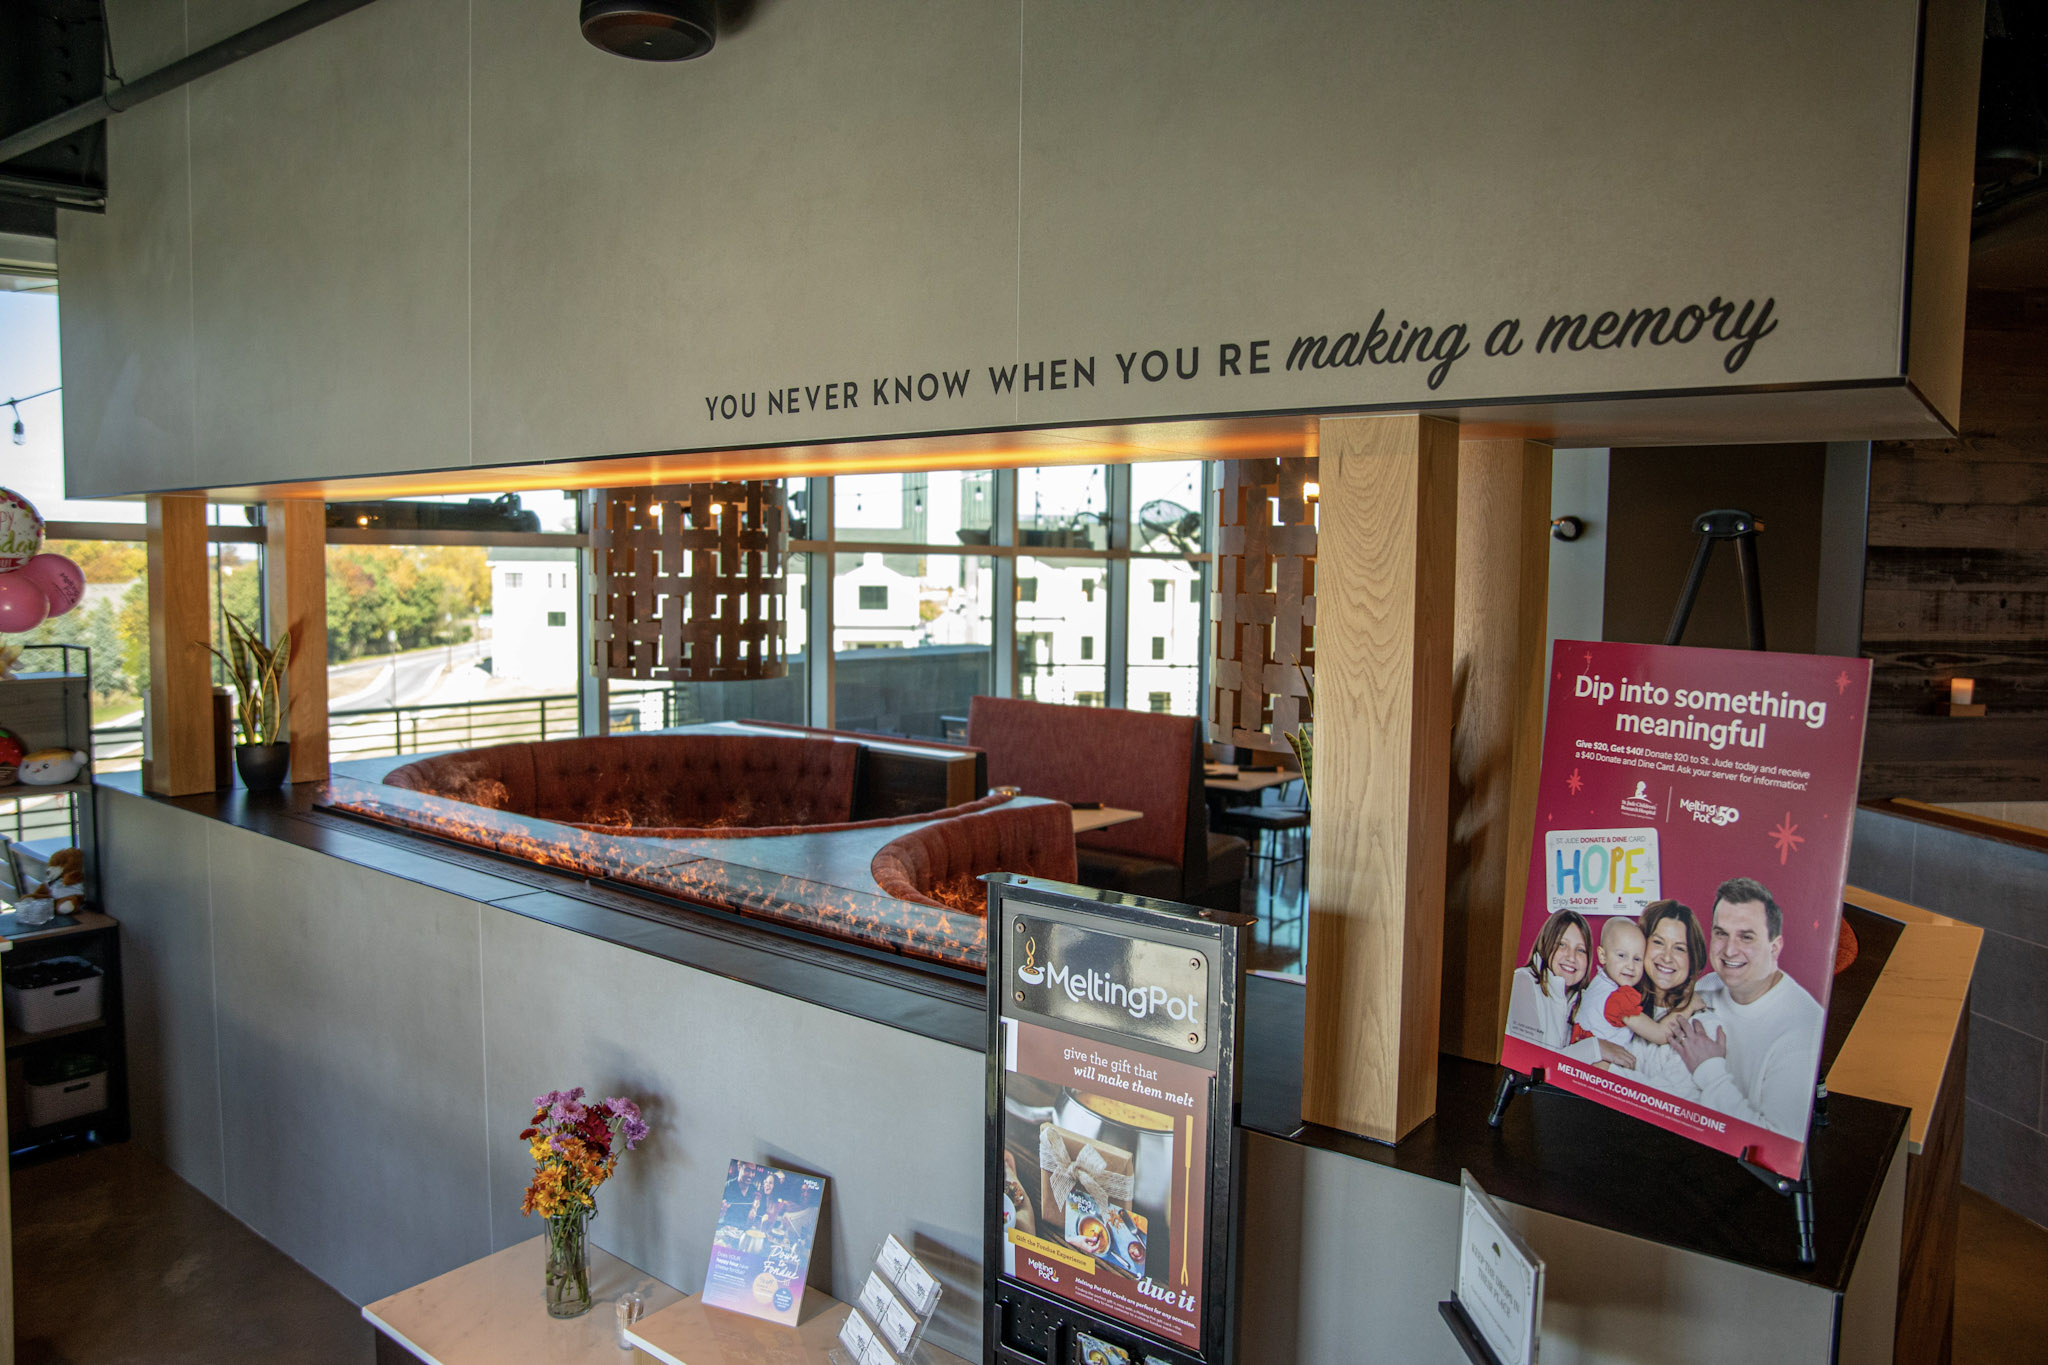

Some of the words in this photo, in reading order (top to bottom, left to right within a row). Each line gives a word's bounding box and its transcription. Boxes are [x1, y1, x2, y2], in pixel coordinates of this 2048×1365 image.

[705, 393, 756, 421] YOU
[768, 381, 859, 416] NEVER
[872, 369, 971, 406] KNOW
[988, 356, 1095, 395] WHEN
[1115, 346, 1200, 385] YOU
[1219, 340, 1271, 377] RE
[1285, 308, 1471, 391] making
[1484, 318, 1524, 357] a
[1535, 296, 1779, 374] memory
[1575, 675, 1614, 705] Dip
[1619, 677, 1669, 705] into
[1674, 690, 1827, 729] something
[1616, 711, 1766, 750] meaningful
[1576, 739, 1593, 749] Give
[1593, 741, 1610, 752] $20,
[1610, 744, 1626, 754] Get
[1626, 746, 1644, 756] $40!
[1644, 748, 1673, 760] Donate
[1674, 752, 1689, 763] $20
[1690, 755, 1699, 764] to
[1712, 758, 1734, 769] Jude
[1734, 760, 1759, 774] today
[1760, 766, 1777, 775] and
[1778, 767, 1811, 780] receive
[1581, 751, 1595, 760] $40
[1596, 753, 1621, 764] Donate
[1622, 758, 1637, 767] and
[1637, 759, 1655, 769] Dine
[1676, 765, 1692, 775] Ask
[1692, 768, 1711, 778] your
[1712, 770, 1738, 781] server
[1739, 773, 1752, 783] for
[1680, 798, 1716, 816] Melting
[1693, 811, 1710, 824] Pot
[1556, 844, 1645, 895] HOPE
[1569, 897, 1583, 905] $40
[1583, 897, 1598, 905] OFF
[1063, 1047, 1088, 1062] give
[1090, 1052, 1108, 1067] the
[1110, 1057, 1131, 1074] gift
[1133, 1063, 1158, 1081] that
[1073, 1063, 1096, 1081] will
[1097, 1069, 1129, 1090] make
[1131, 1080, 1162, 1100] them
[1165, 1090, 1194, 1108] melt
[1557, 1062, 1727, 1133] MELTINGPOT.COM/DONATEANDDINE
[1027, 1238, 1036, 1247] the
[1036, 1241, 1056, 1254] Fondue
[1056, 1250, 1087, 1266] Experience
[1028, 1257, 1054, 1275] Melting
[763, 1260, 800, 1280] Fondue
[1038, 1269, 1050, 1281] Pot
[1178, 1290, 1196, 1312] it
